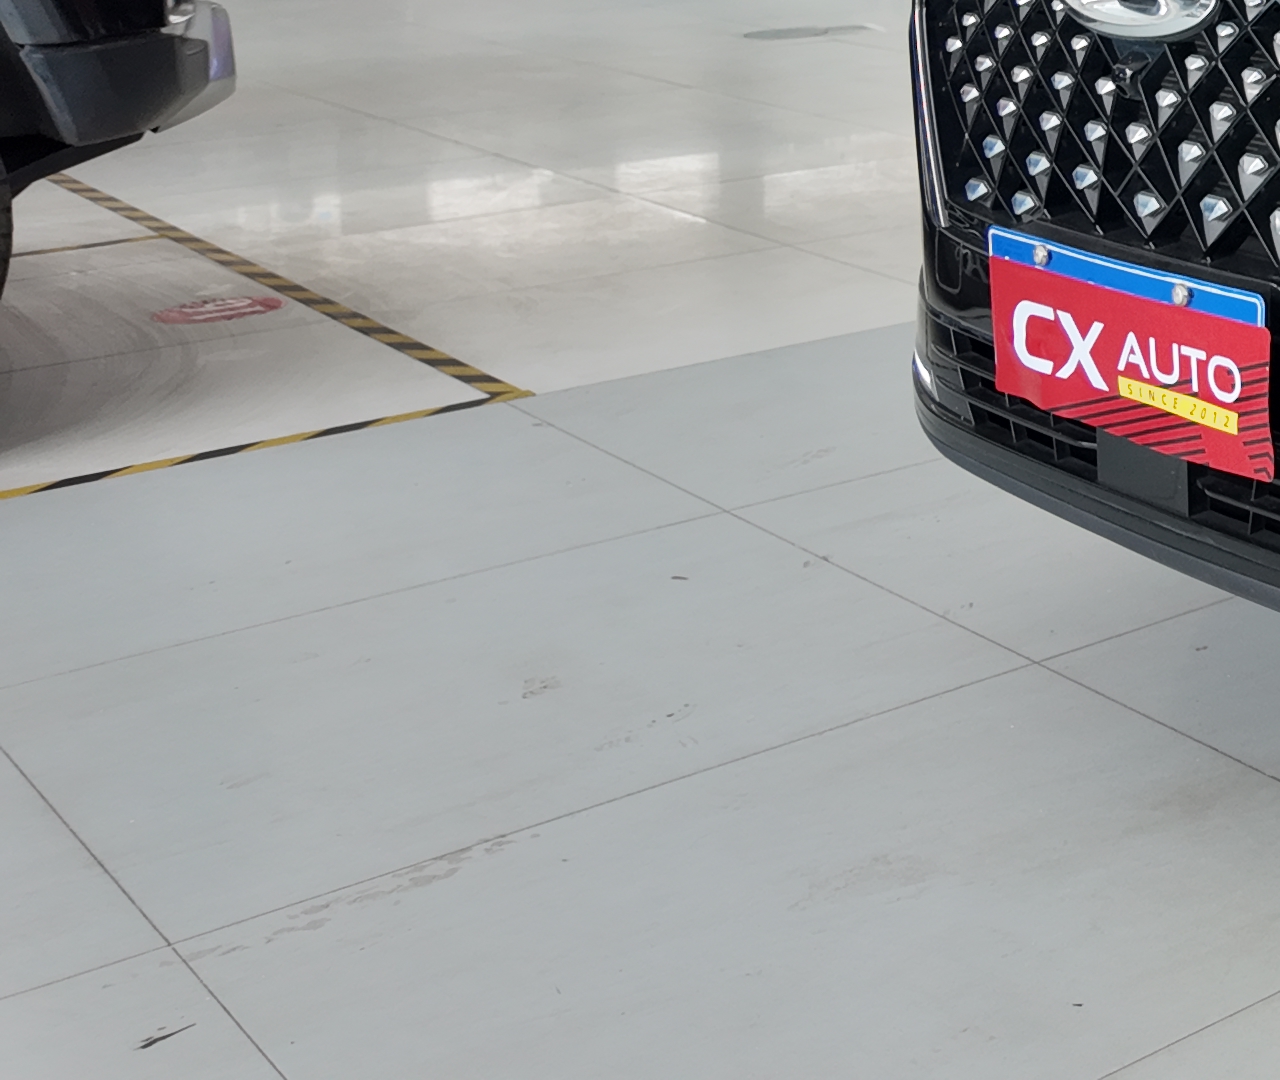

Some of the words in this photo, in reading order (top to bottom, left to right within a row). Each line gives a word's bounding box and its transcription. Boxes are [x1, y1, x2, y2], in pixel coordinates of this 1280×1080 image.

[1012, 299, 1110, 392] CX
[1117, 331, 1242, 403] AUTO
[1127, 383, 1180, 410] SINCE
[1189, 402, 1231, 428] 2012
